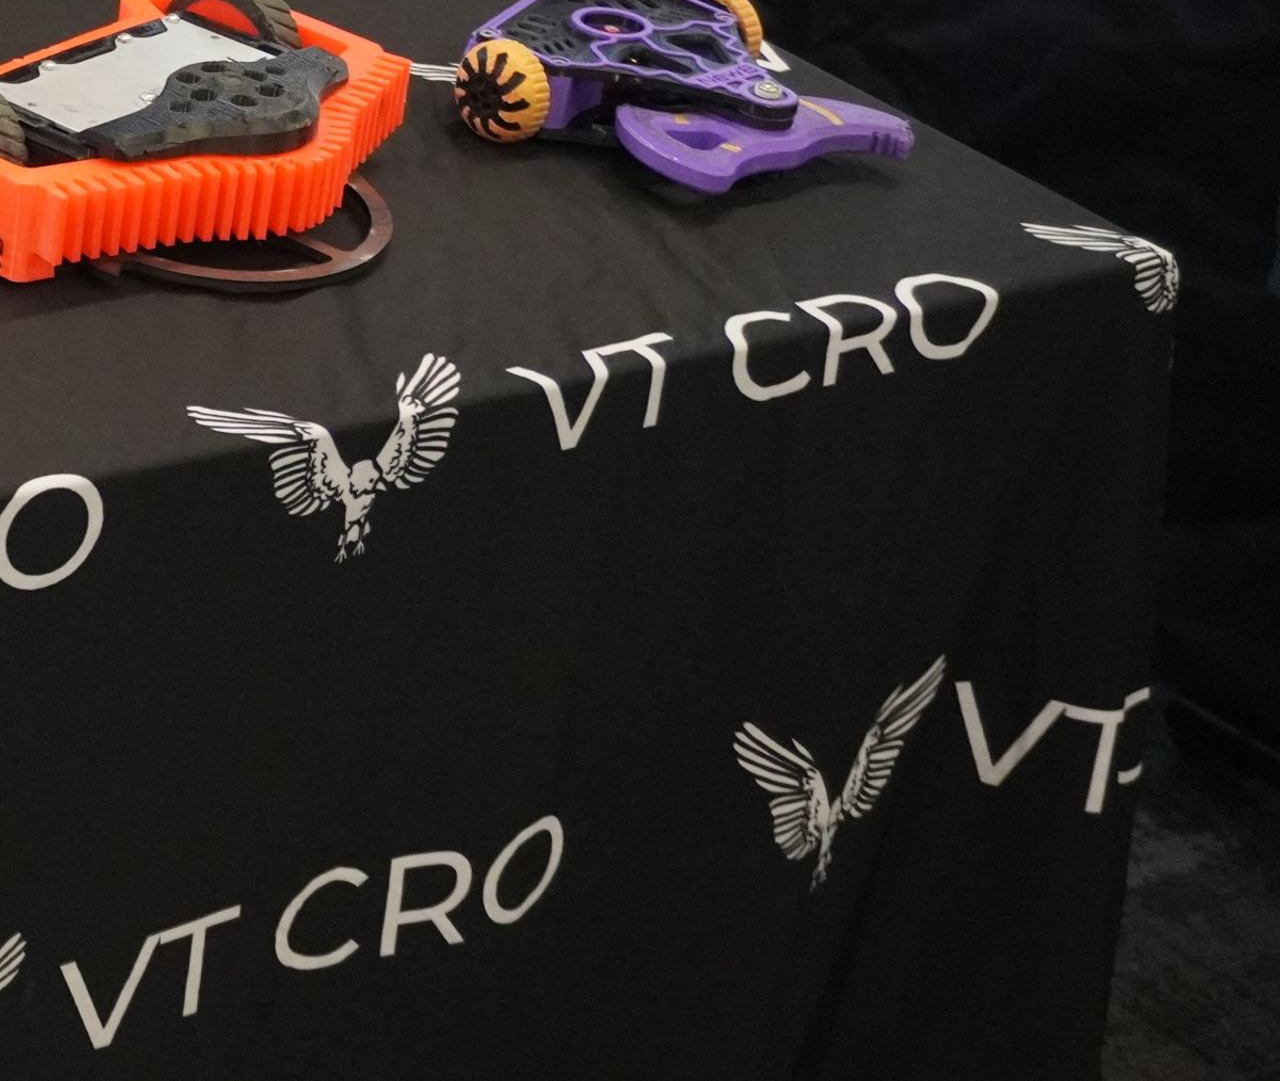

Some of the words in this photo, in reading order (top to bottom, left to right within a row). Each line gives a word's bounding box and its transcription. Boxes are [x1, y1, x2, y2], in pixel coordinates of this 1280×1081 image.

[505, 332, 673, 450] VT
[724, 273, 998, 401] CRO
[955, 680, 1124, 813] VT
[60, 906, 240, 1049] VT
[276, 816, 563, 969] CRO
